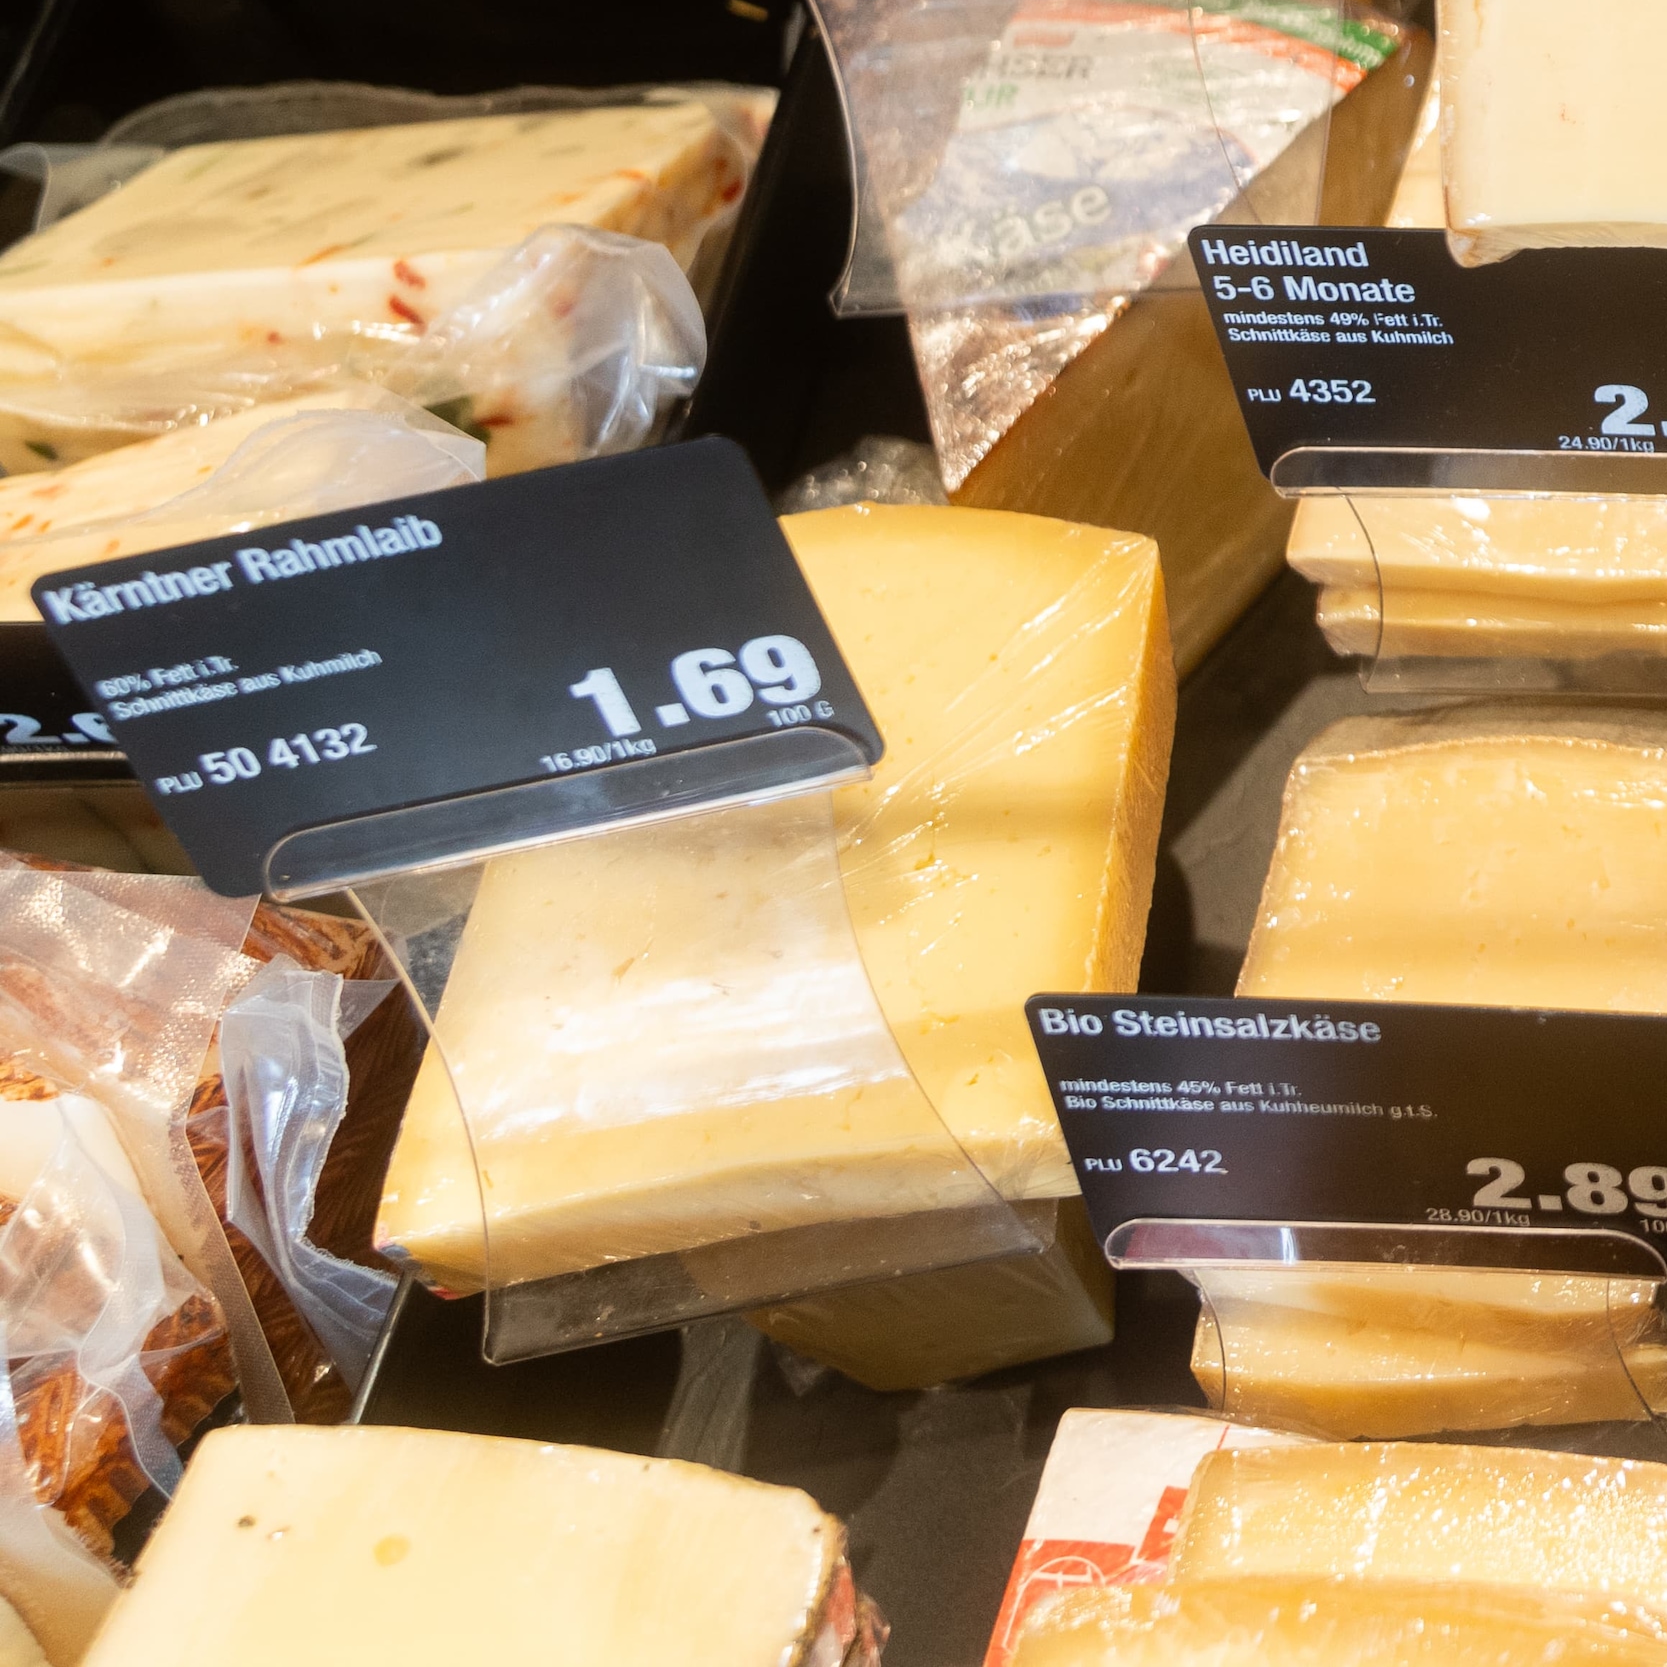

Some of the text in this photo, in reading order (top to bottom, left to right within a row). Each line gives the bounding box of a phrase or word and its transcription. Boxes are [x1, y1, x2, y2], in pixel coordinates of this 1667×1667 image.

[1201, 239, 1369, 267] Heidiland
[1213, 275, 1416, 303] 5-6 Monate
[1223, 312, 1325, 326] mindestens
[1330, 312, 1370, 327] 49%
[1228, 327, 1454, 345] Schnittkäse aus Kuhmilch
[1247, 378, 1376, 404] PLU 4352
[1558, 435, 1655, 453] 24.90/1kg
[41, 514, 443, 625] Kärntner Rahmlaib
[108, 648, 383, 722] Schnittkäse Kuhmilch
[569, 634, 821, 738] 1.69
[199, 722, 377, 786] 50 4132
[540, 738, 656, 773] 16.90/1kg
[1038, 1008, 1382, 1043] Bio Steinsalzkäse
[1060, 1079, 1172, 1094] mindestens
[1102, 1096, 1214, 1113] Schnittkäse
[1085, 1149, 1228, 1175] PLU 6242
[1426, 1207, 1530, 1227] 28.90/1kg
